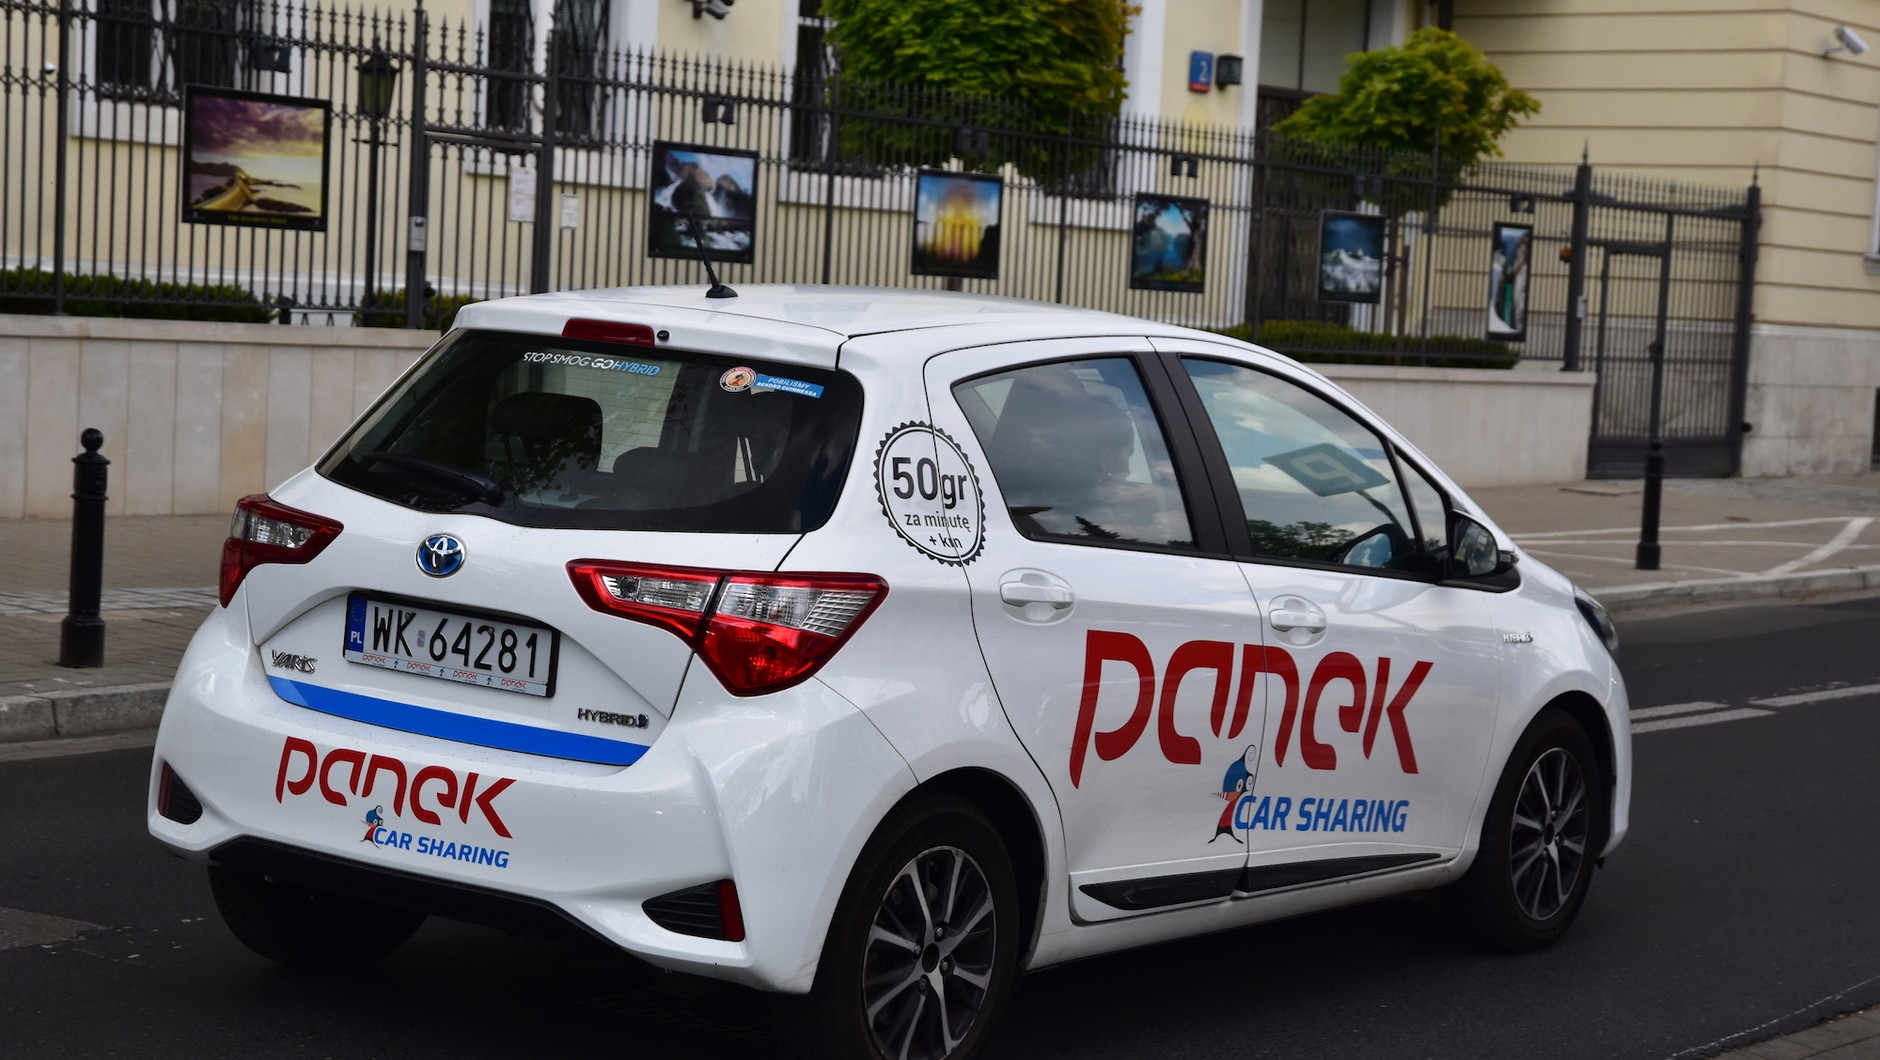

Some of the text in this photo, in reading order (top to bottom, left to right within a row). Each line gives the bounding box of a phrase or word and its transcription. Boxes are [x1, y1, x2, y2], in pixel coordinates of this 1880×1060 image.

[1198, 60, 1210, 82] 2
[904, 510, 972, 533] za minutę
[938, 532, 964, 549] km
[350, 631, 363, 644] PL
[373, 606, 538, 678] WK 64281
[577, 707, 637, 728] HYBRID
[1234, 795, 1410, 833] CAR SHARING
[374, 827, 510, 869] CAR SHARING
